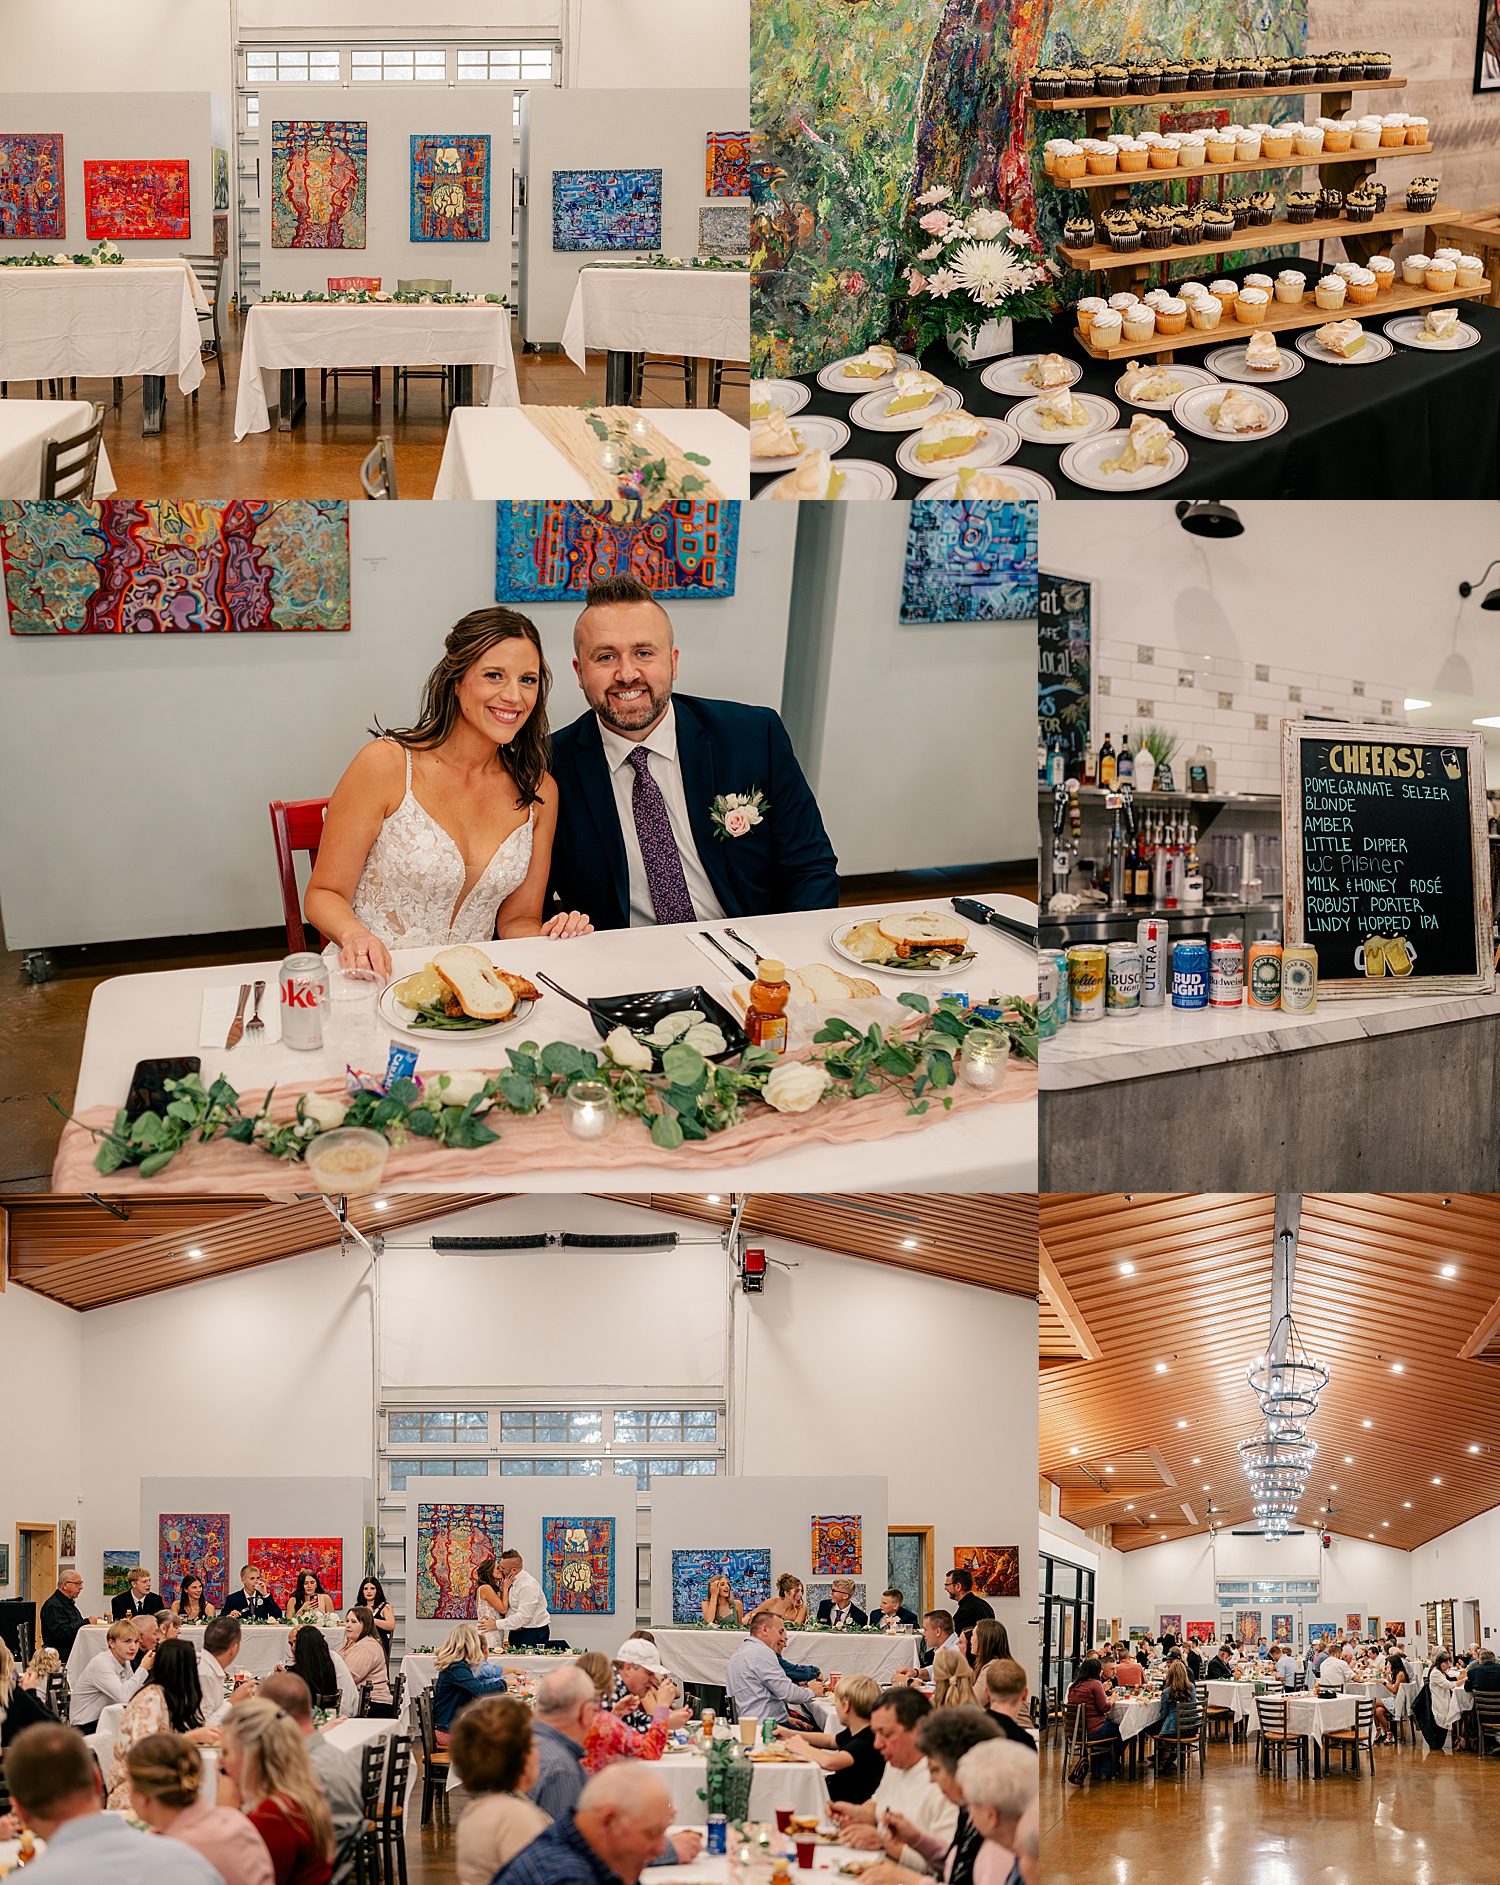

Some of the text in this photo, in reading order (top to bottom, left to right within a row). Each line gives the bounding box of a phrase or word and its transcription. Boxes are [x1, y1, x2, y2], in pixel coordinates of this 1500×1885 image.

[340, 279, 365, 288] LOVE
[1329, 745, 1425, 779] CHEERS!
[1304, 777, 1450, 801] POMEGRANATE SELZER
[1305, 795, 1356, 812] BLONDE
[1304, 816, 1354, 832] AMBER
[1304, 836, 1408, 853] LITTLE DIPPER
[1306, 855, 1405, 873] WC Pilsner
[1307, 876, 1340, 892] MILK
[1354, 878, 1397, 893] HONEY
[1410, 876, 1443, 893] ROSÉ
[1307, 896, 1424, 914] ROBUST PORTER
[1307, 914, 1439, 932] LINDY HOPPED IPA
[1145, 945, 1157, 990] ULTRA
[1255, 958, 1268, 968] DAY
[1068, 974, 1103, 986] Golden
[1111, 973, 1140, 985] BUSC
[1174, 972, 1201, 985] BUD
[1286, 961, 1298, 970] DAY
[1299, 961, 1313, 986] BREWING
[1119, 984, 1140, 992] LIGHT
[1172, 981, 1206, 996] LIGHT
